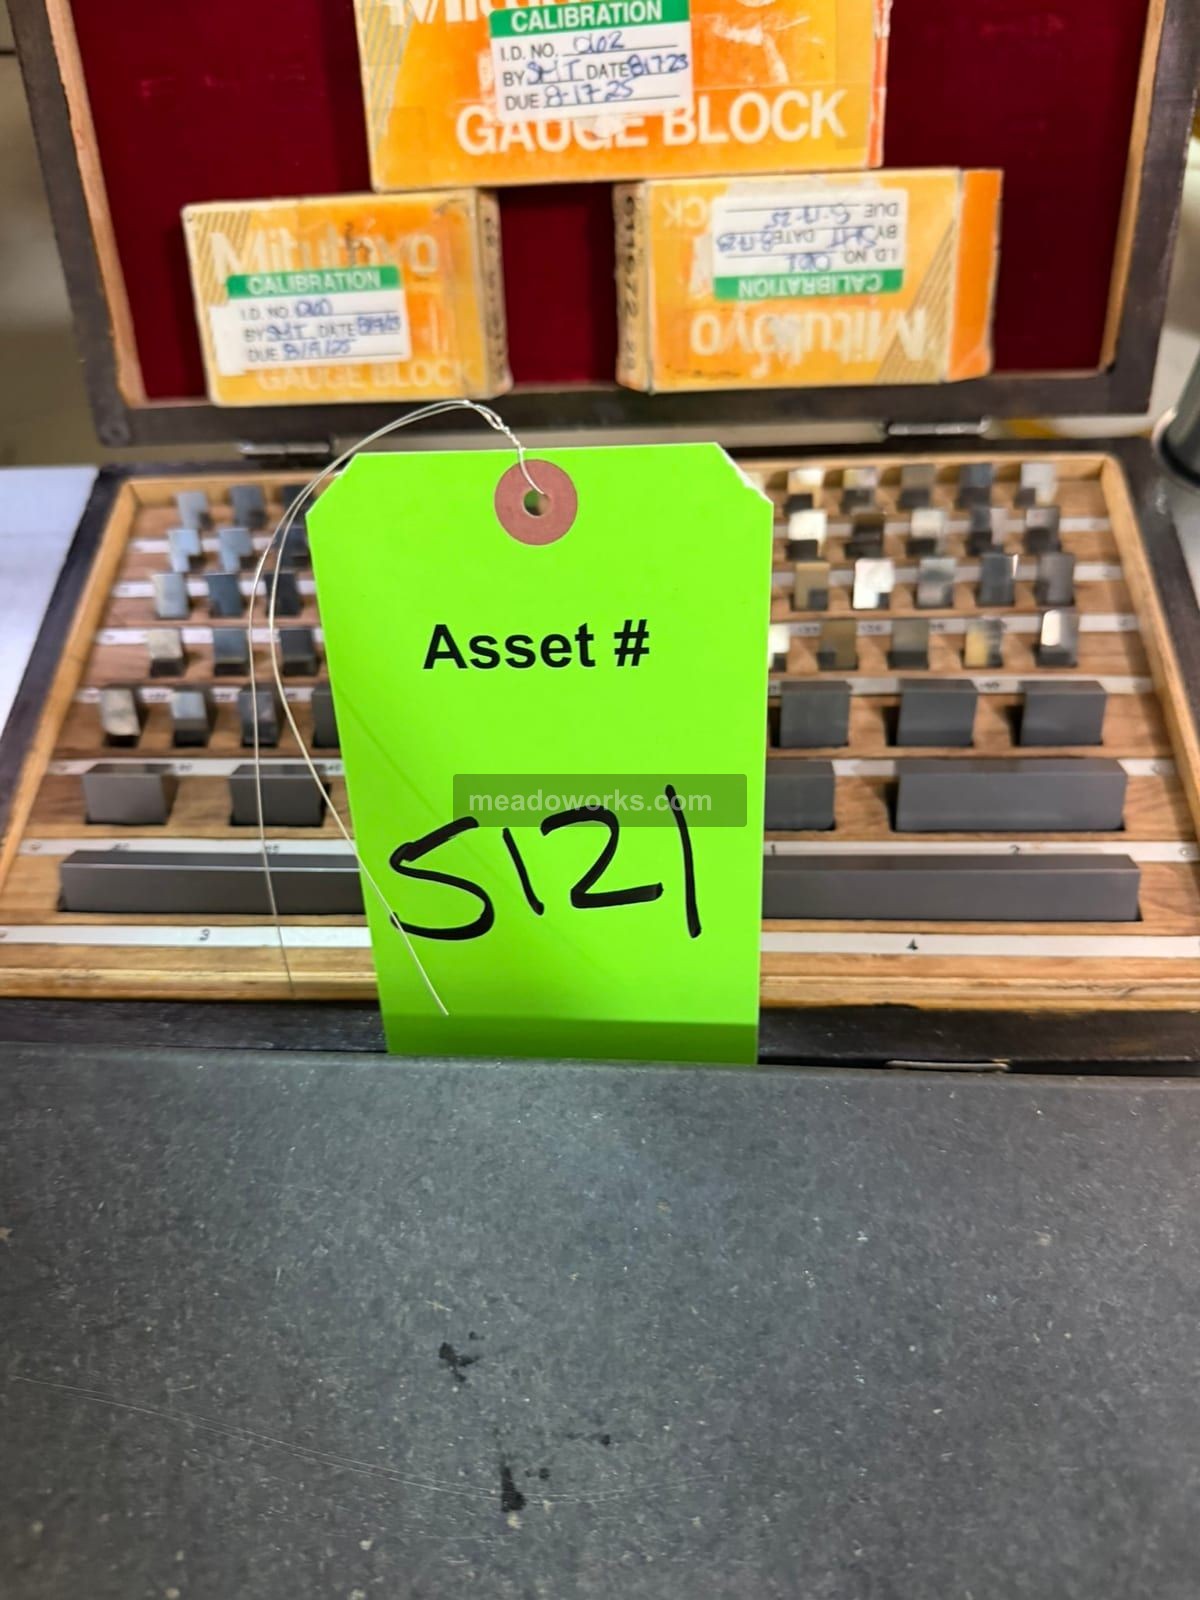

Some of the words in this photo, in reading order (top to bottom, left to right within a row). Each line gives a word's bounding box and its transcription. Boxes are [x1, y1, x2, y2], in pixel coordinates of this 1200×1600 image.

[511, 0, 662, 32] CALIBRATION
[501, 47, 526, 61] I.D.
[503, 72, 525, 87] BY
[587, 62, 629, 79] DATE
[505, 94, 539, 110] DUE
[663, 89, 847, 147] BLOCK
[864, 202, 899, 218] DUE
[773, 229, 815, 244] DATE
[877, 225, 897, 239] BY
[246, 270, 381, 294] CALIBRATION
[739, 273, 883, 299] CALIBRATION
[244, 328, 263, 342] BY
[318, 323, 356, 338] DATE
[249, 347, 278, 361] DUE
[423, 622, 596, 670] Asset
[613, 619, 650, 667] #
[199, 928, 210, 941] 3
